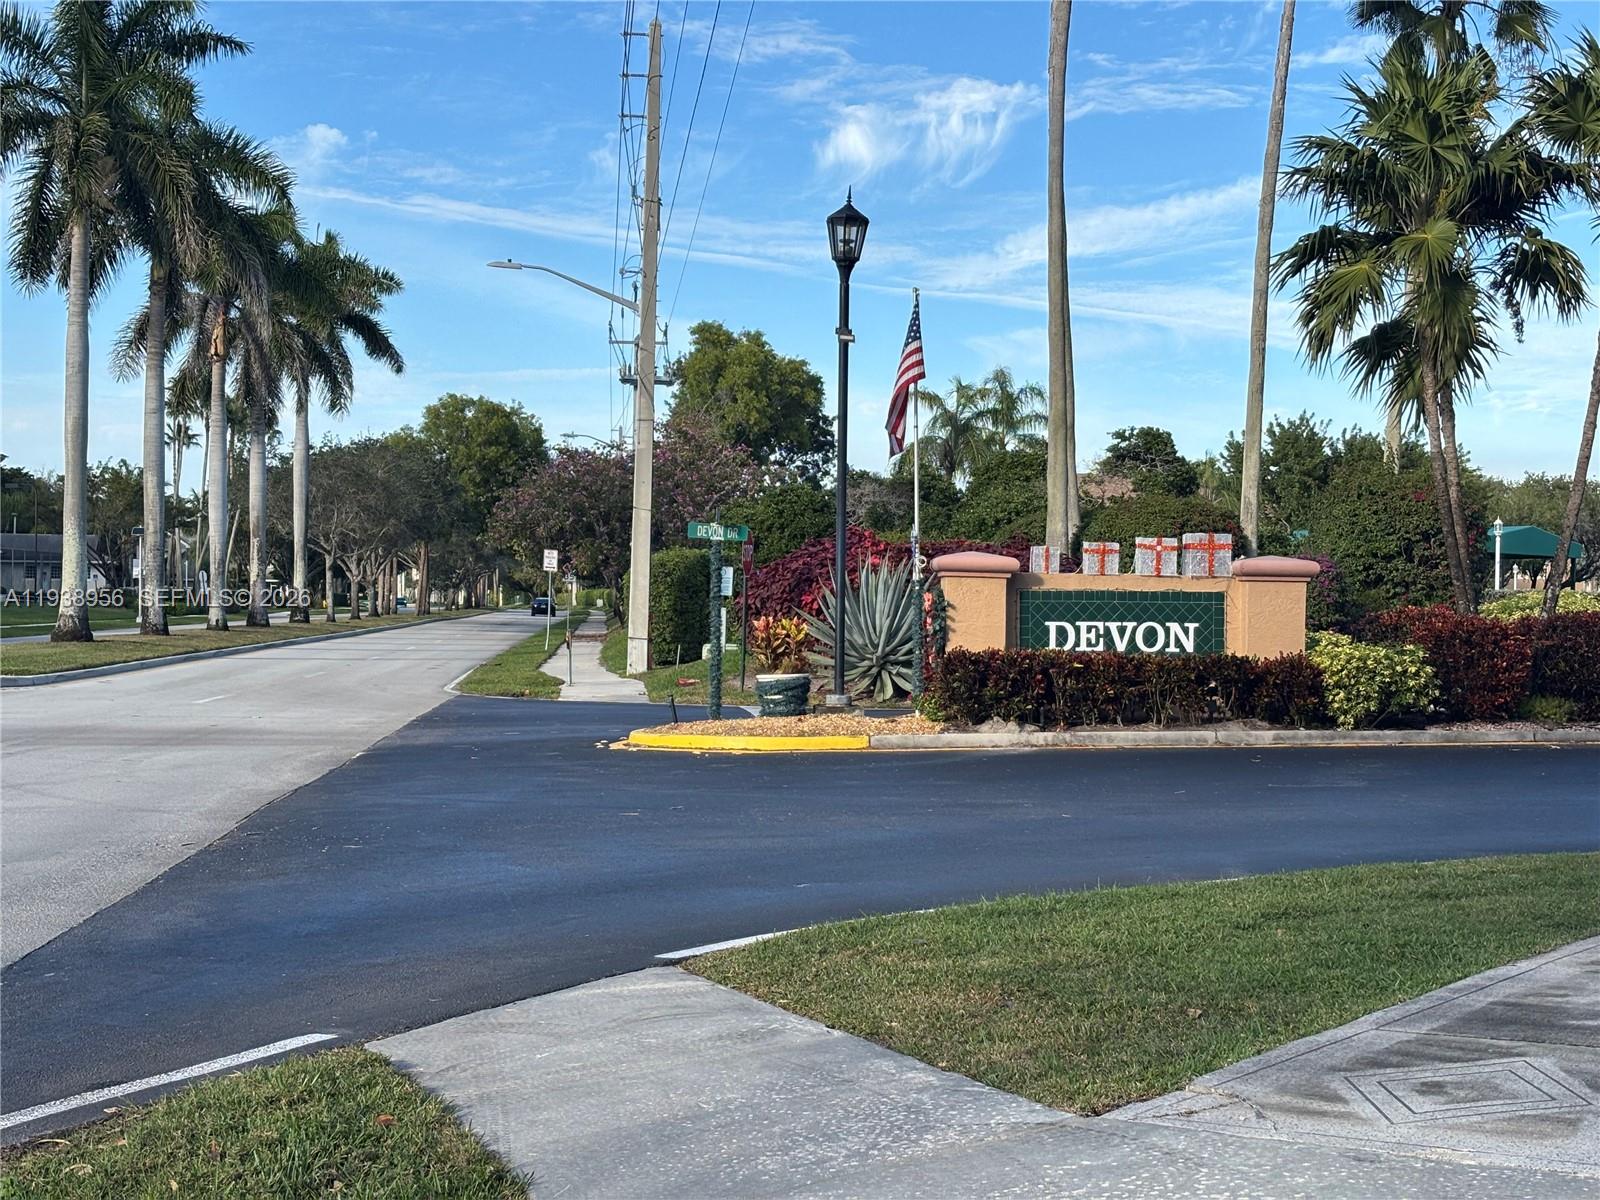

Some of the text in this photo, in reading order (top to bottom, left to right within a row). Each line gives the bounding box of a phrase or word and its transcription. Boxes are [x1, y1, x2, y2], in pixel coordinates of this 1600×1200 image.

[697, 525, 739, 539] DEVON DR
[1044, 620, 1200, 653] DEVON
